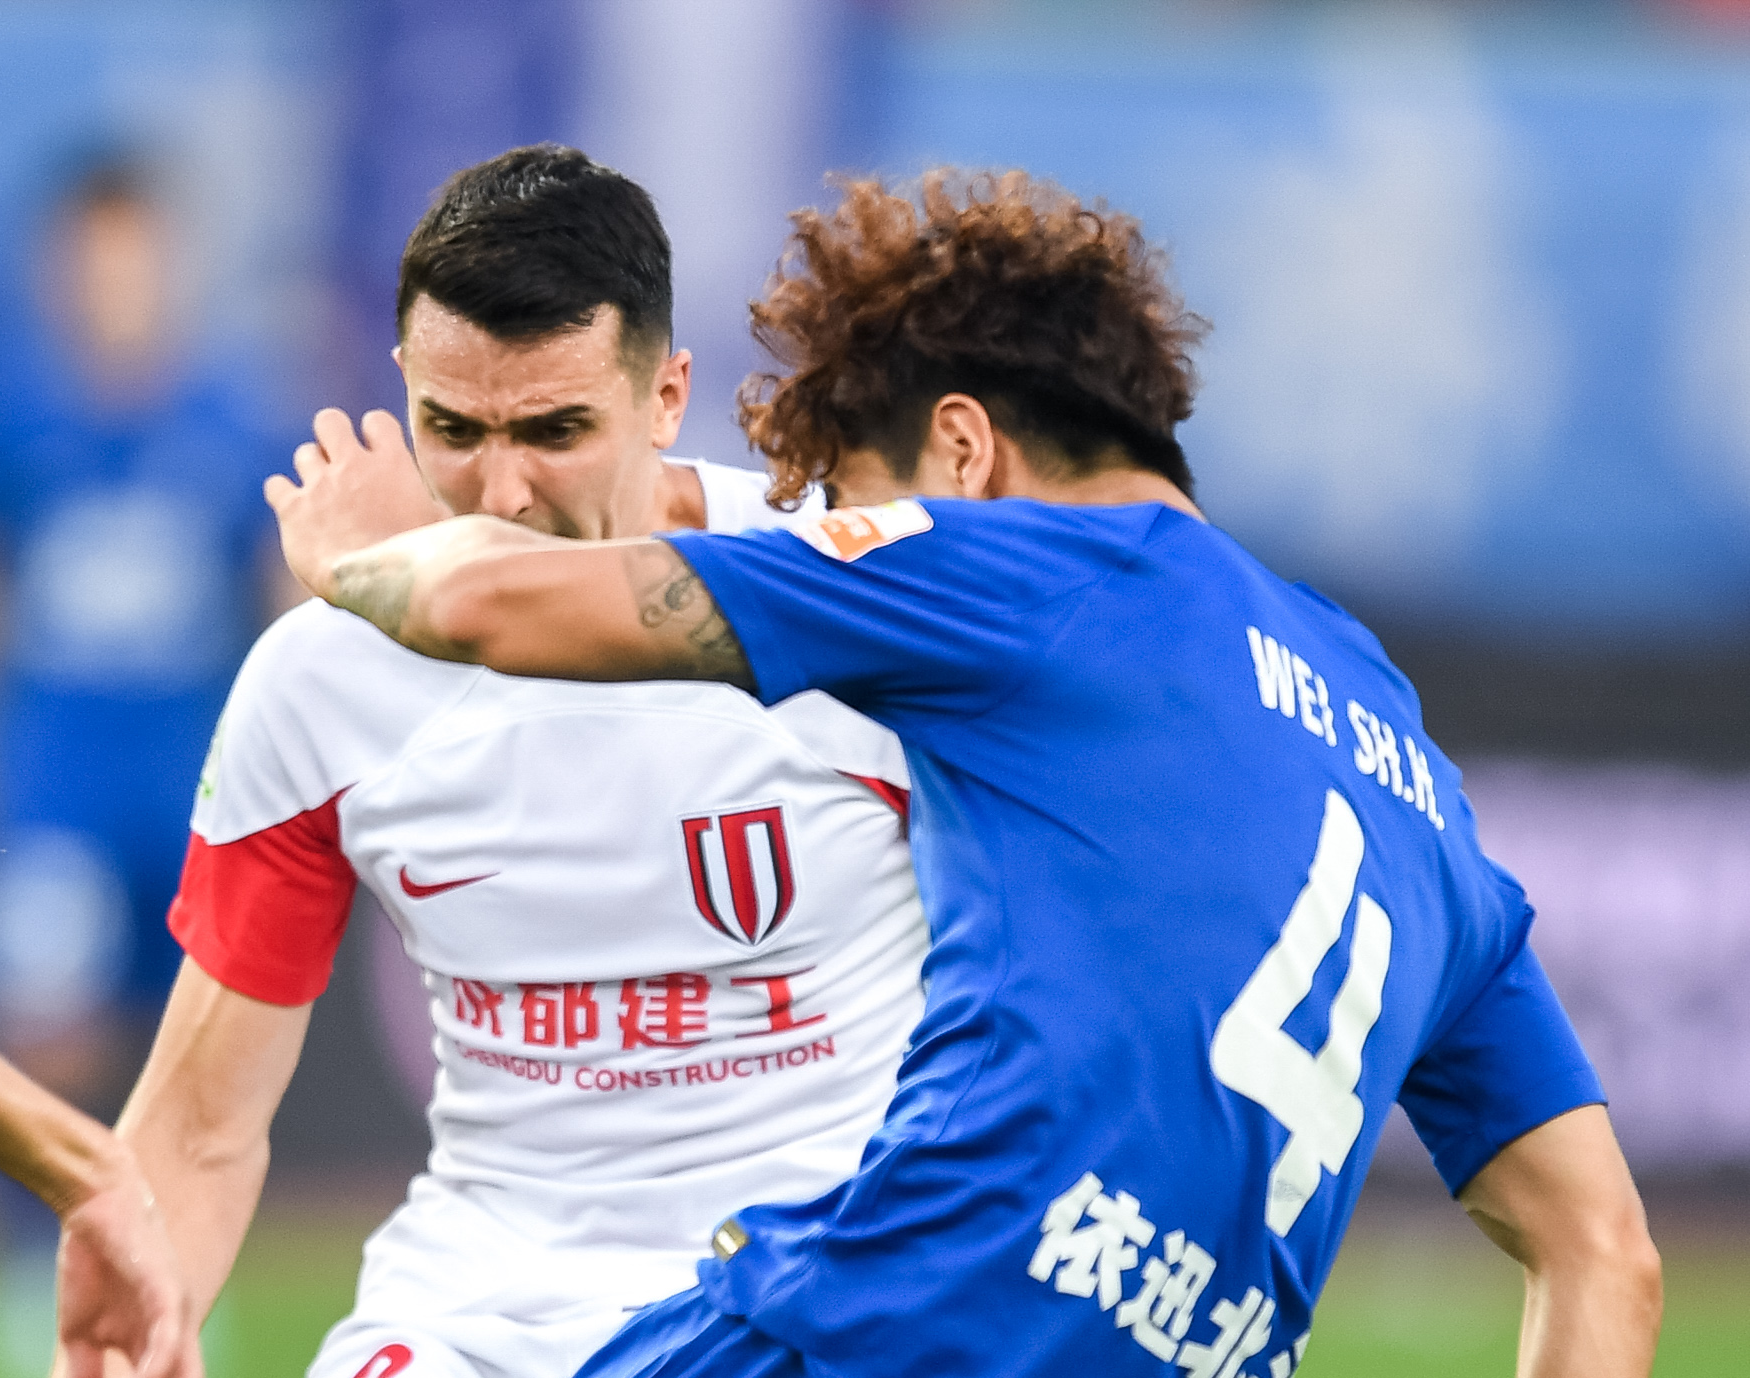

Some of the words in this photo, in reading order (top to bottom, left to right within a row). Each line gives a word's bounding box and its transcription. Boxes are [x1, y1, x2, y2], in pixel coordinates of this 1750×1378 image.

[1245, 624, 1338, 748] WEI
[1346, 698, 1446, 832] SH.H.
[574, 1034, 837, 1092] CONSTRUCTION
[1210, 787, 1393, 1239] 4
